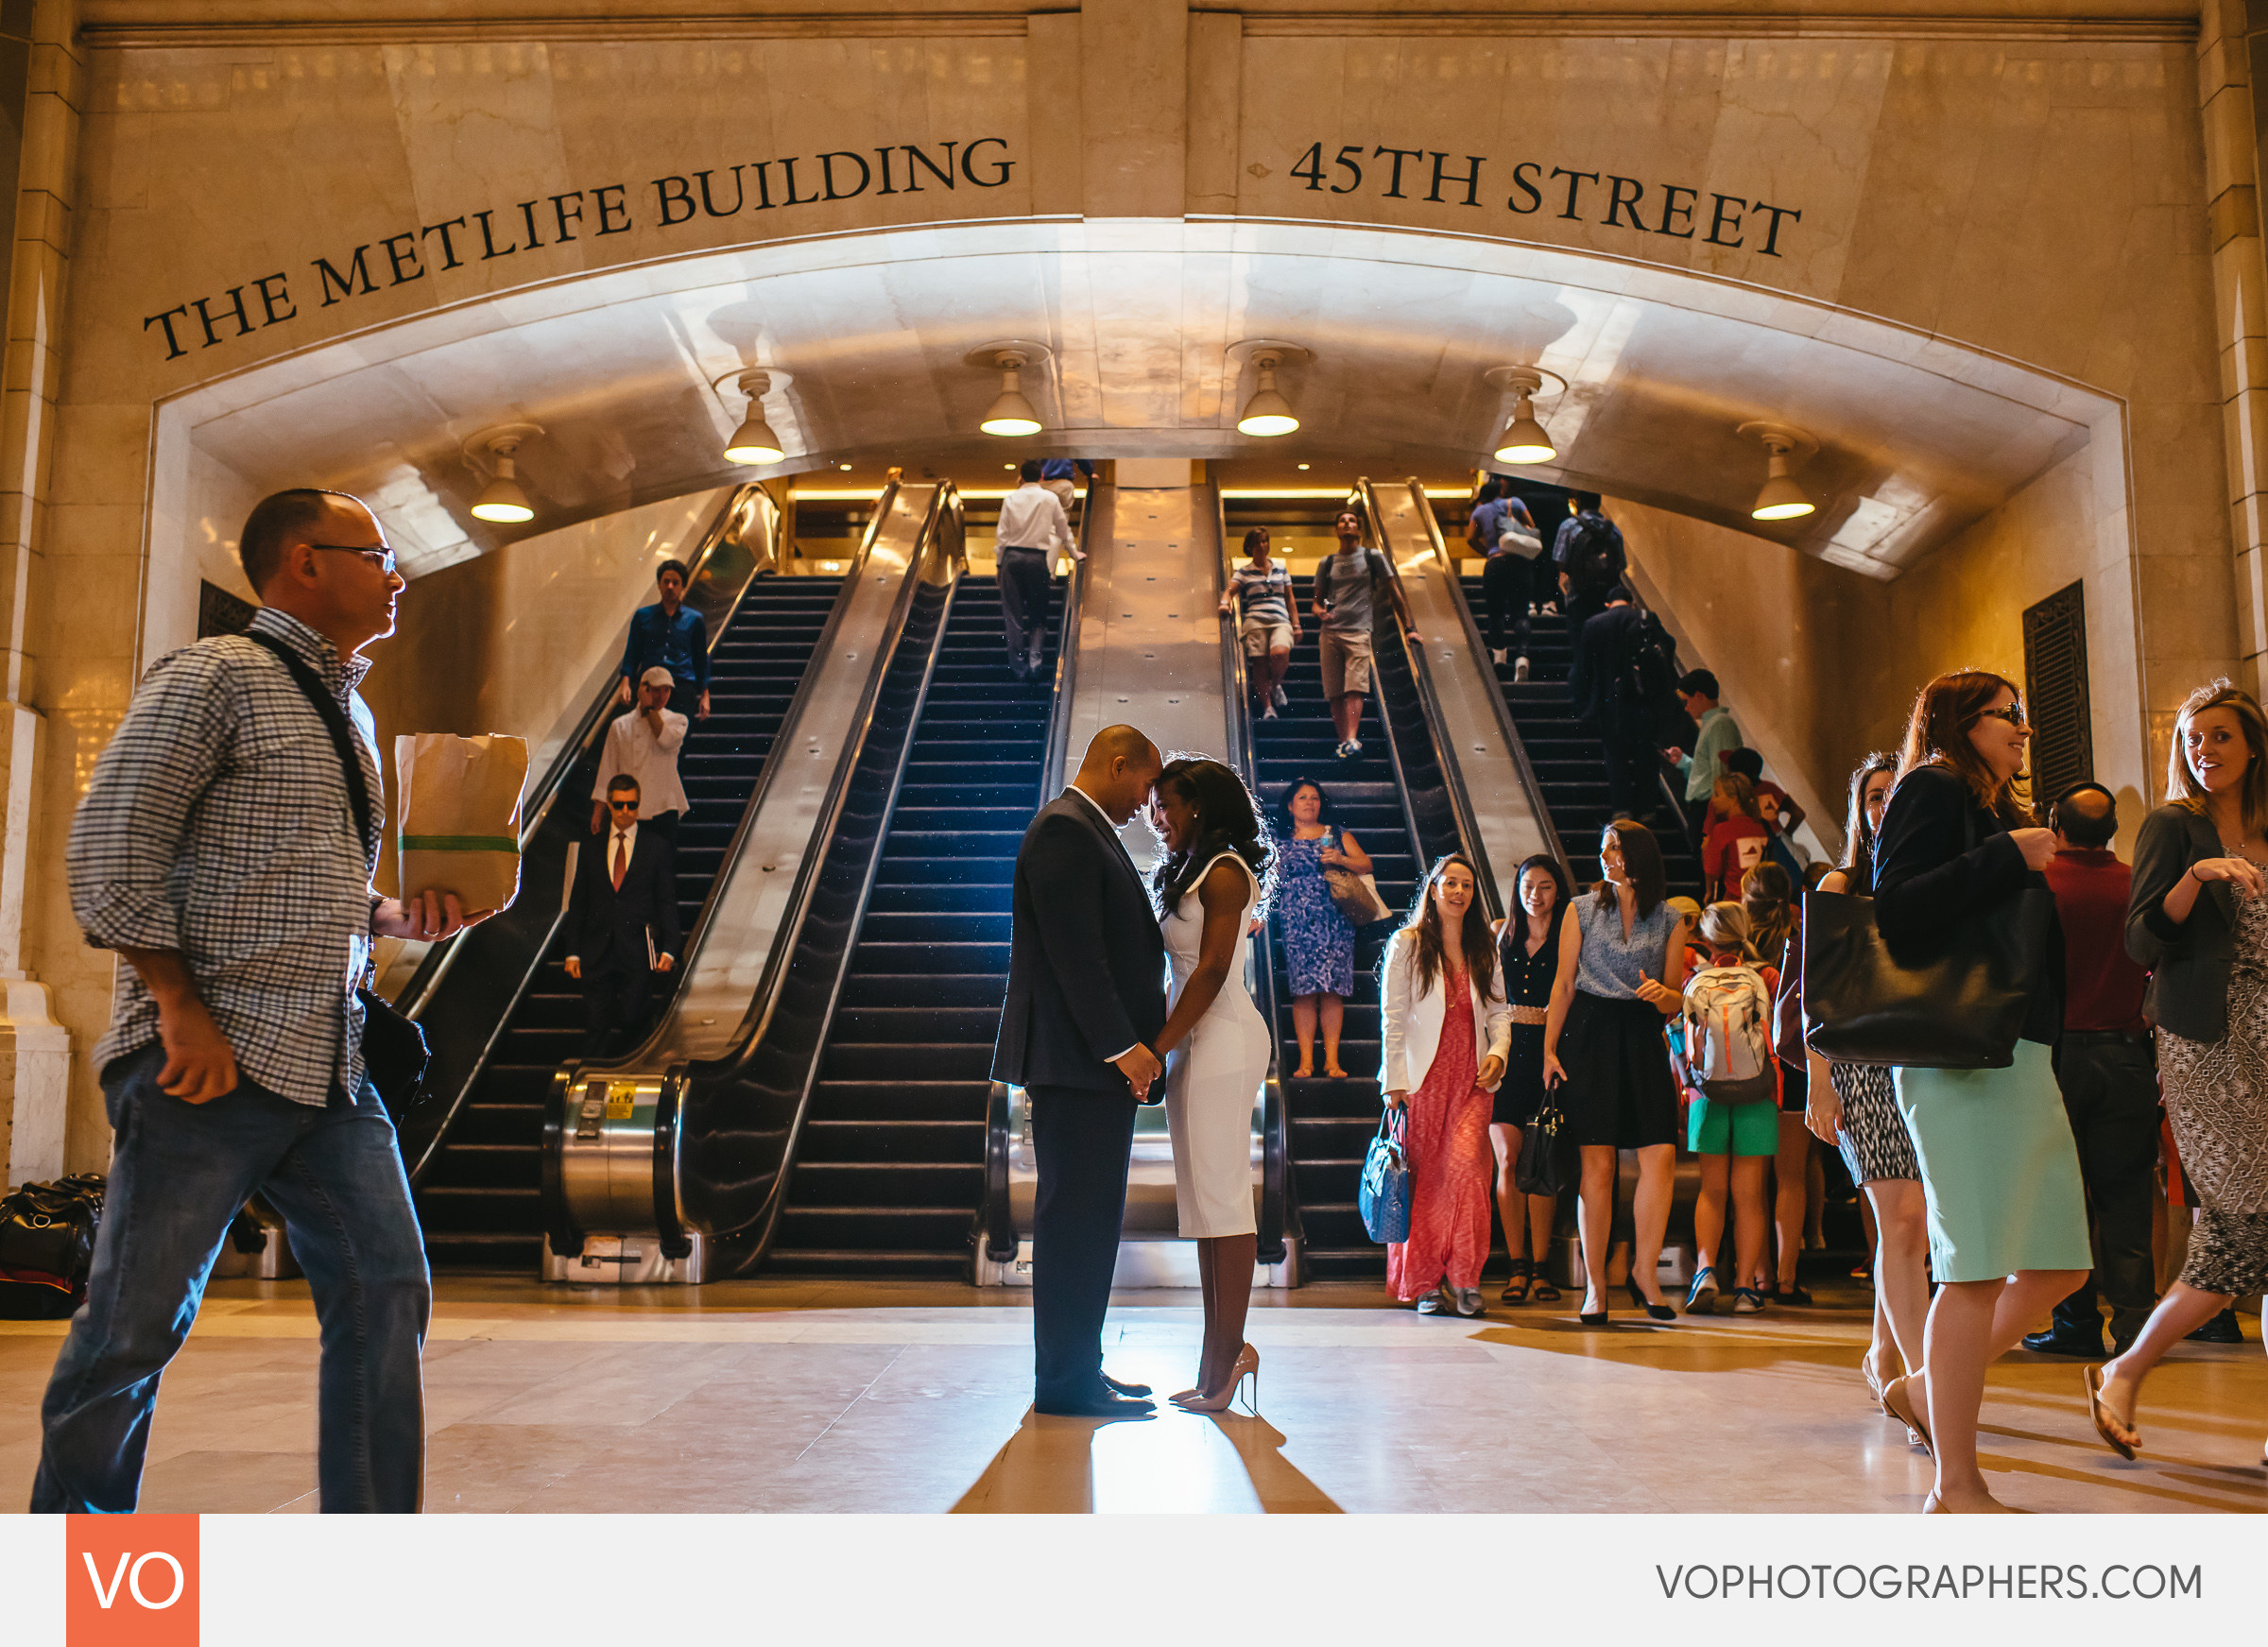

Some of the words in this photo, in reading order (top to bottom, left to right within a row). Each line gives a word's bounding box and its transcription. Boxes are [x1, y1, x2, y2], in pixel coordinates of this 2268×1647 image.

[143, 271, 298, 362] THE
[310, 183, 632, 308] METLIFE
[650, 137, 1017, 228] BUILDING
[1290, 142, 1487, 208] 45TH
[1507, 162, 1802, 258] STREET
